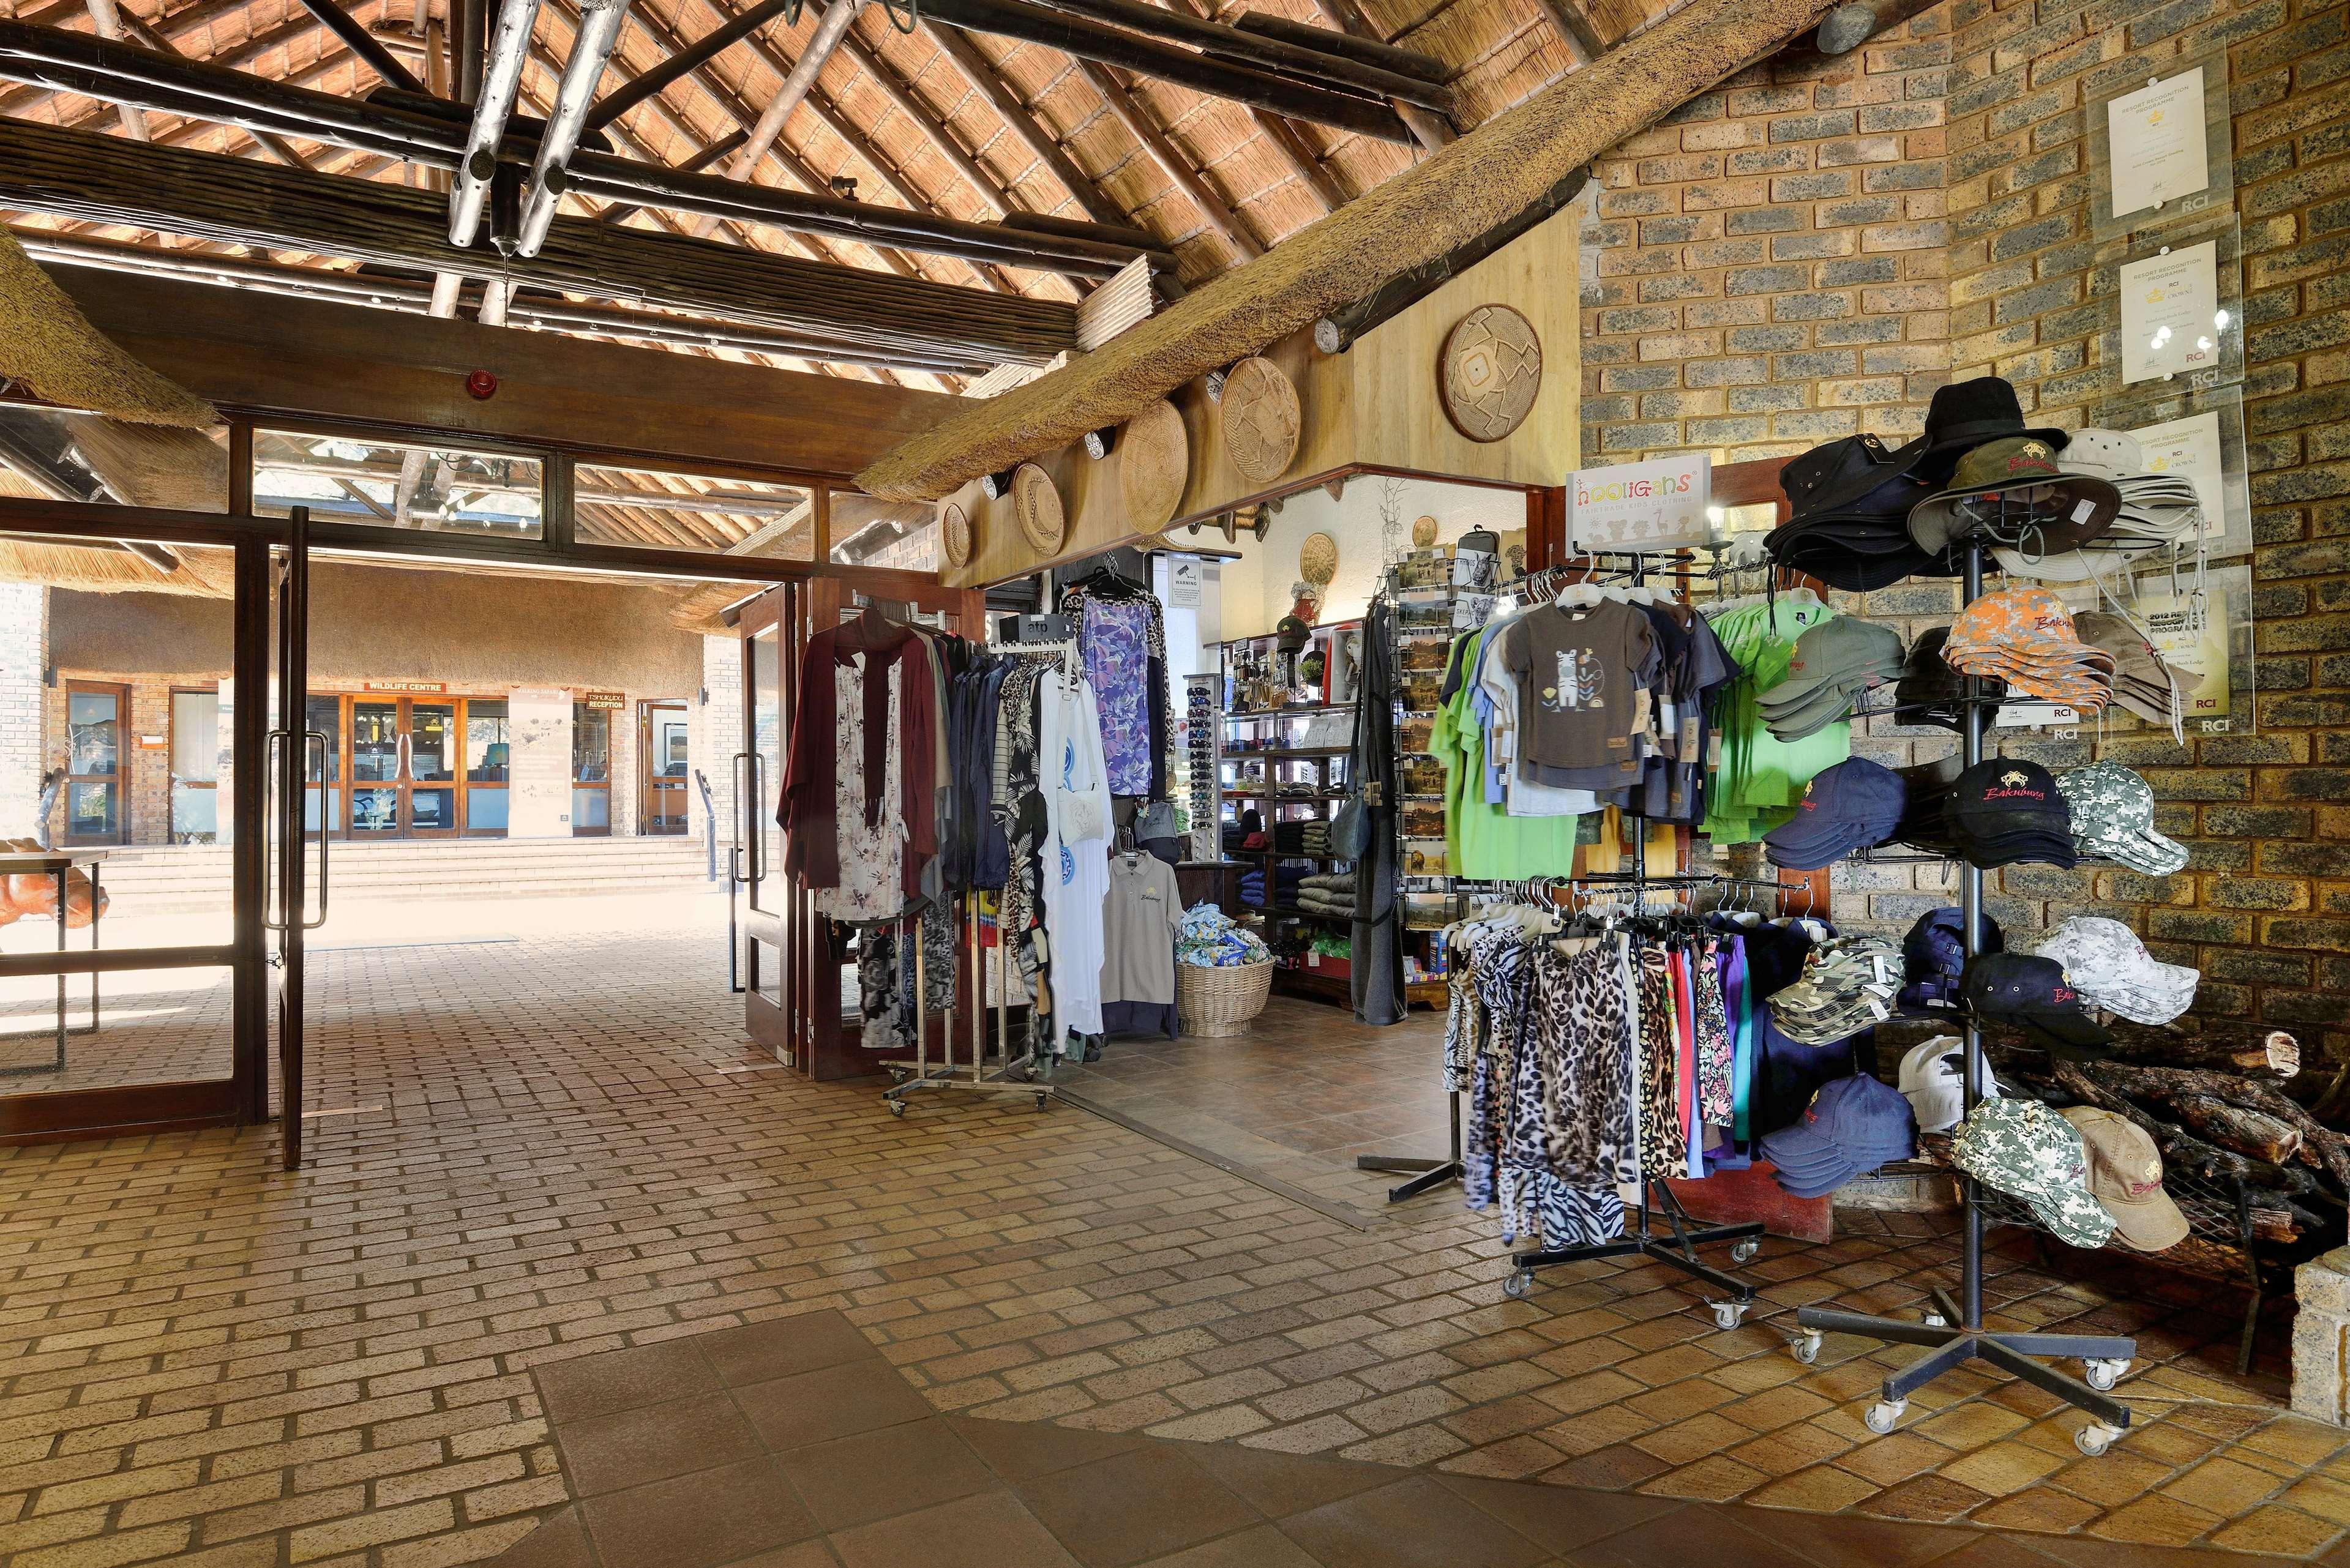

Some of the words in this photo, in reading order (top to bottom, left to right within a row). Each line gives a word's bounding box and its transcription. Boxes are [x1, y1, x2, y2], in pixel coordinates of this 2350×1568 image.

[2122, 102, 2145, 113] RESORT
[2147, 86, 2189, 104] RECOGNITION
[2136, 96, 2175, 114] PROGRAMME
[2182, 195, 2209, 213] RCI
[2134, 270, 2157, 280] RESORT
[2159, 258, 2202, 273] RECOGNITION
[2147, 267, 2187, 282] PROGRAMME
[2186, 352, 2206, 362] RCI
[2190, 369, 2219, 386] RCI
[2162, 428, 2203, 441] RECOGNITION
[2150, 436, 2190, 449] PROGRAMME
[1581, 505, 1626, 515] FAIRTRADE
[1629, 501, 1648, 509] KIDS
[1653, 496, 1692, 506] CLOTHING
[2149, 611, 2169, 620] 2012
[1027, 621, 1048, 635] atp
[409, 683, 441, 692] CENTRE
[2196, 699, 2216, 709] RCI
[2054, 709, 2071, 717] RCI
[2202, 719, 2229, 733] RCI
[2054, 728, 2078, 740] RCI
[1983, 786, 2045, 801] Bakubung
